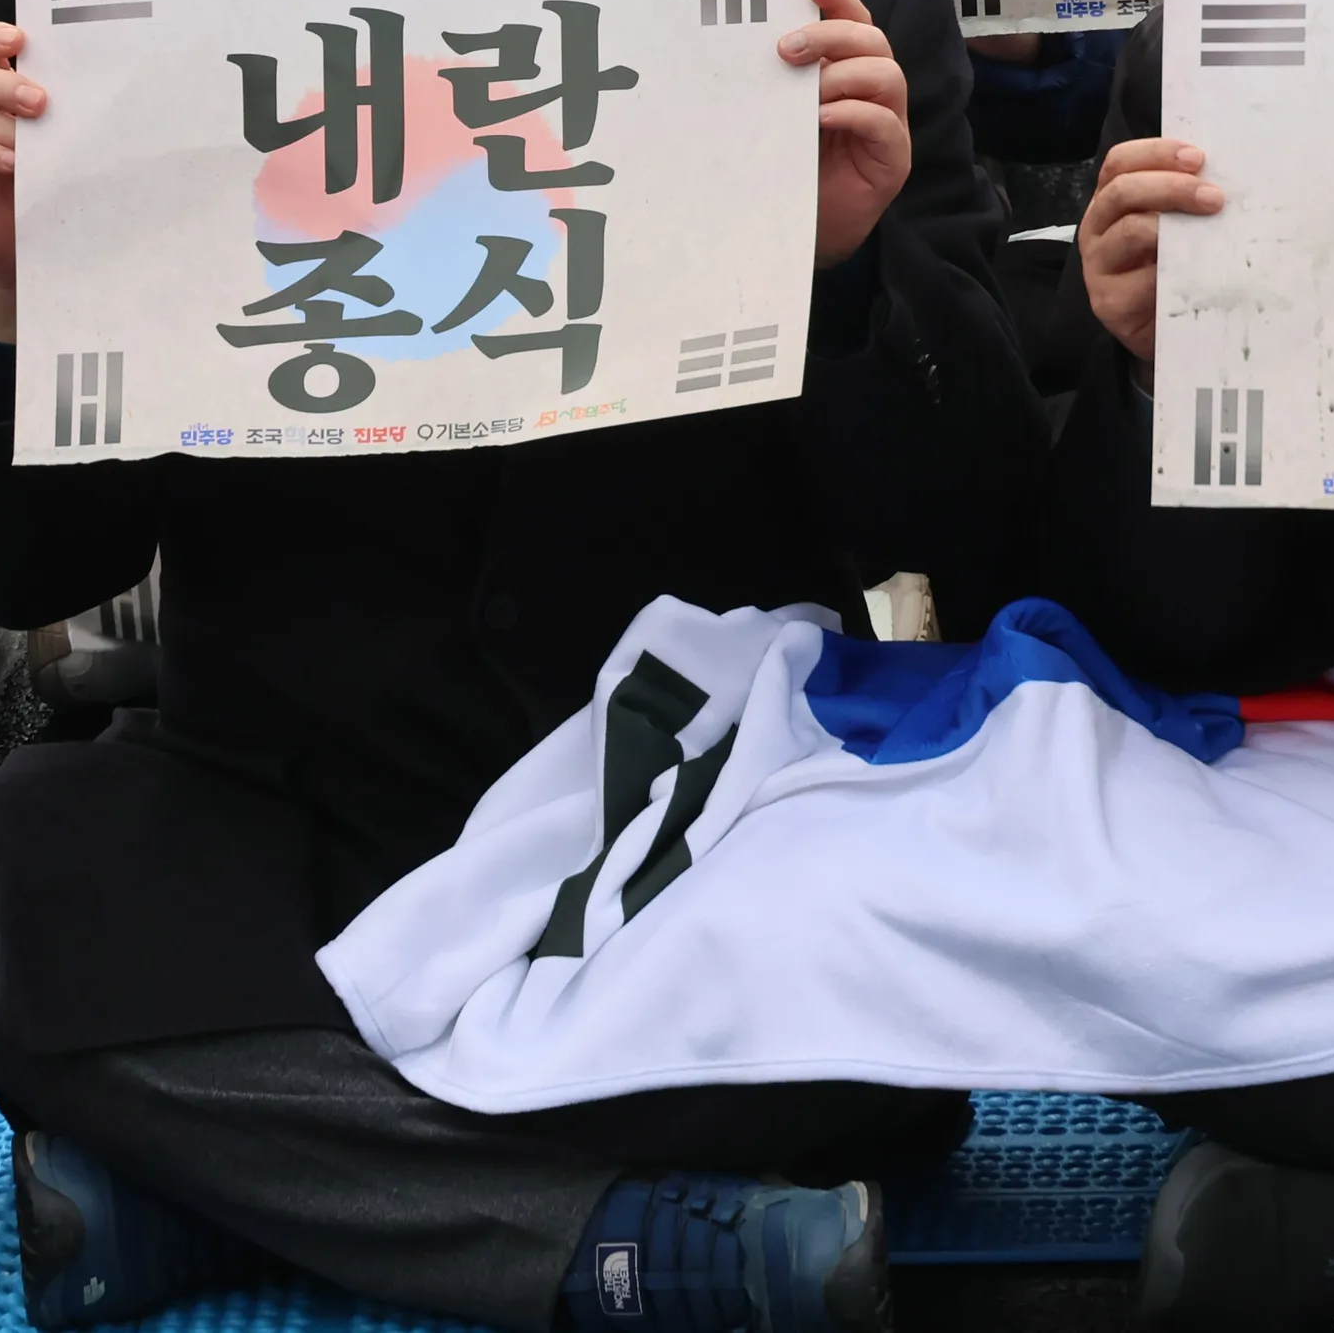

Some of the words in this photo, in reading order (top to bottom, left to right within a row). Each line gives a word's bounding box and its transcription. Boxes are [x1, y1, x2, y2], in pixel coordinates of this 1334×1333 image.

[226, 0, 639, 206] 내란
[216, 207, 608, 414] 종식
[354, 425, 406, 444] 진보당
